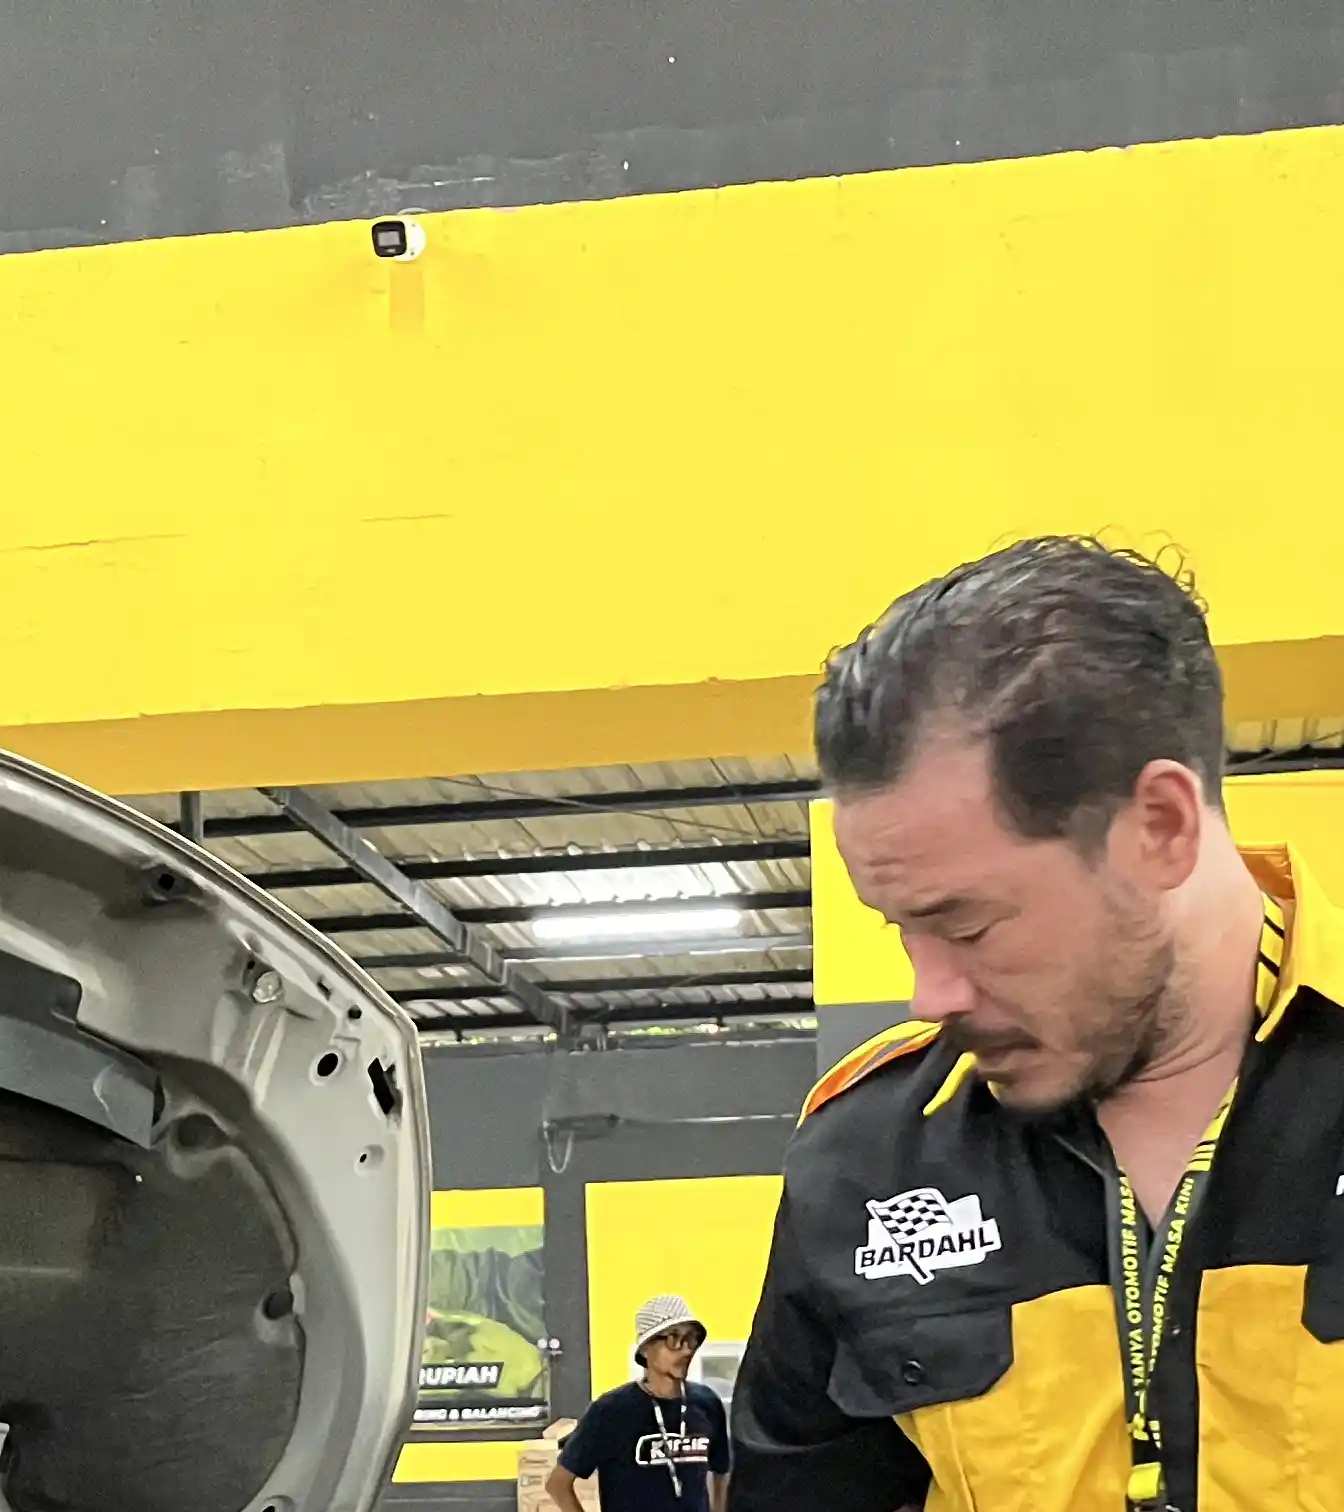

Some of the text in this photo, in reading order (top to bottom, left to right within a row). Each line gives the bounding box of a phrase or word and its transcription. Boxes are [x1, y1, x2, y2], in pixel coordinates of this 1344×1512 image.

[860, 1226, 994, 1268] BARDAHL
[1160, 1219, 1186, 1273] MASA
[1174, 1178, 1195, 1215] KINI
[1121, 1228, 1143, 1324] OTOMOTIF
